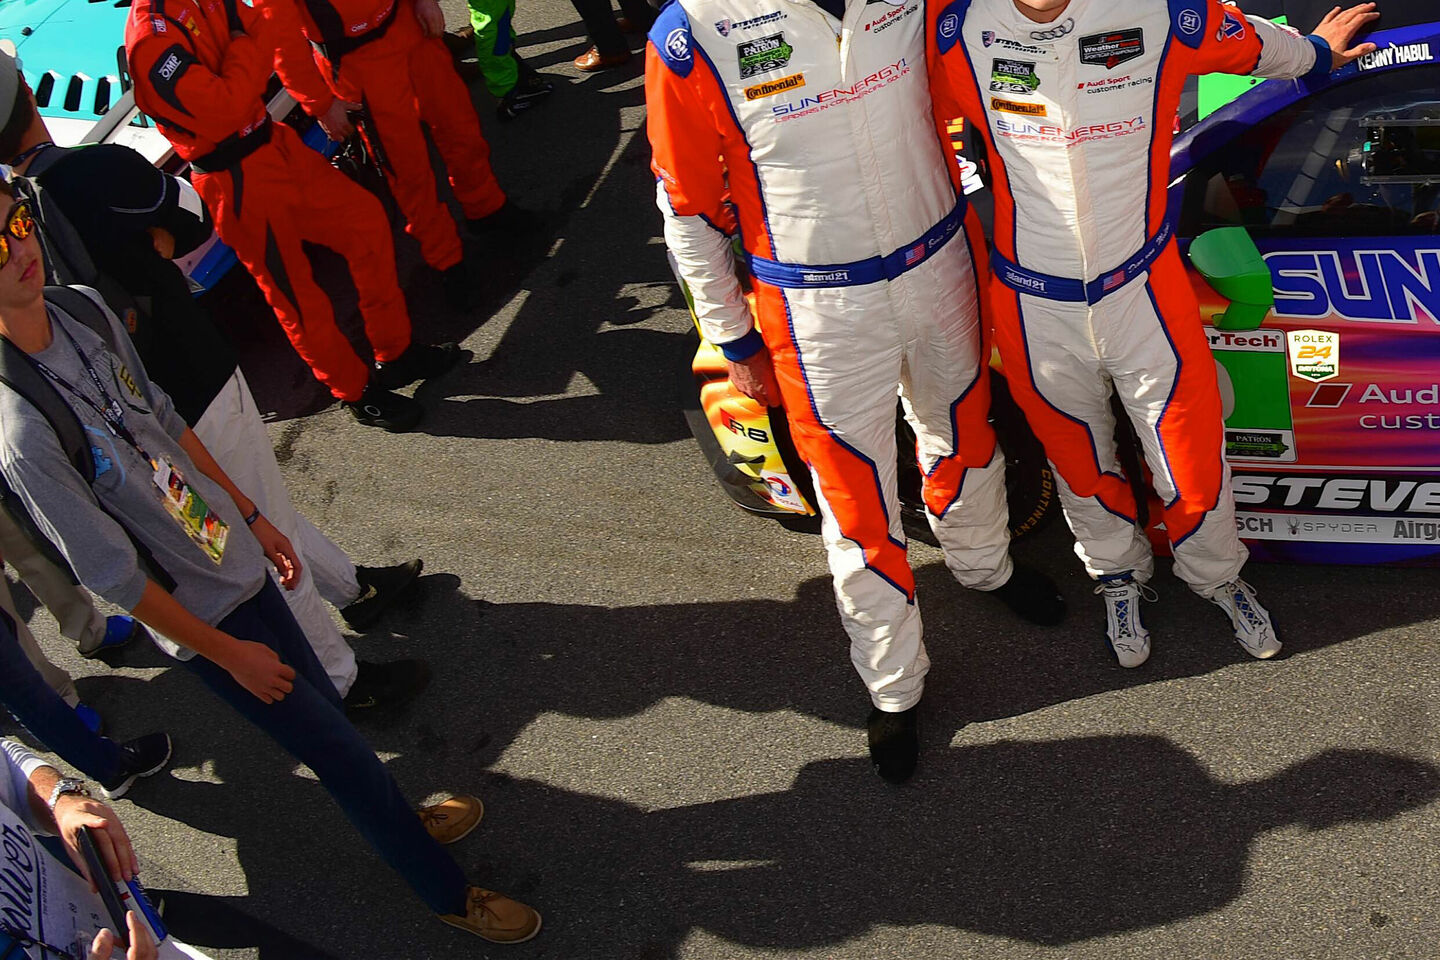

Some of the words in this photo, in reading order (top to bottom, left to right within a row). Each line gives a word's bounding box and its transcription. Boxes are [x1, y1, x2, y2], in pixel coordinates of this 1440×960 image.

[1395, 43, 1433, 63] HABUL
[161, 54, 182, 79] OMP
[746, 74, 804, 100] Continental
[772, 57, 908, 117] SUNENERGY1
[1086, 79, 1106, 87] Audi
[1106, 75, 1131, 84] Sport
[1087, 83, 1125, 94] customer
[1127, 76, 1153, 87] racing
[992, 97, 1045, 116] Continental
[996, 116, 1145, 141] SUNENERGY1
[1293, 334, 1333, 344] ROLEX
[1296, 344, 1333, 360] 24
[1297, 363, 1334, 374] DAYTONA
[729, 415, 769, 444] R8
[1303, 521, 1379, 533] SPYDER
